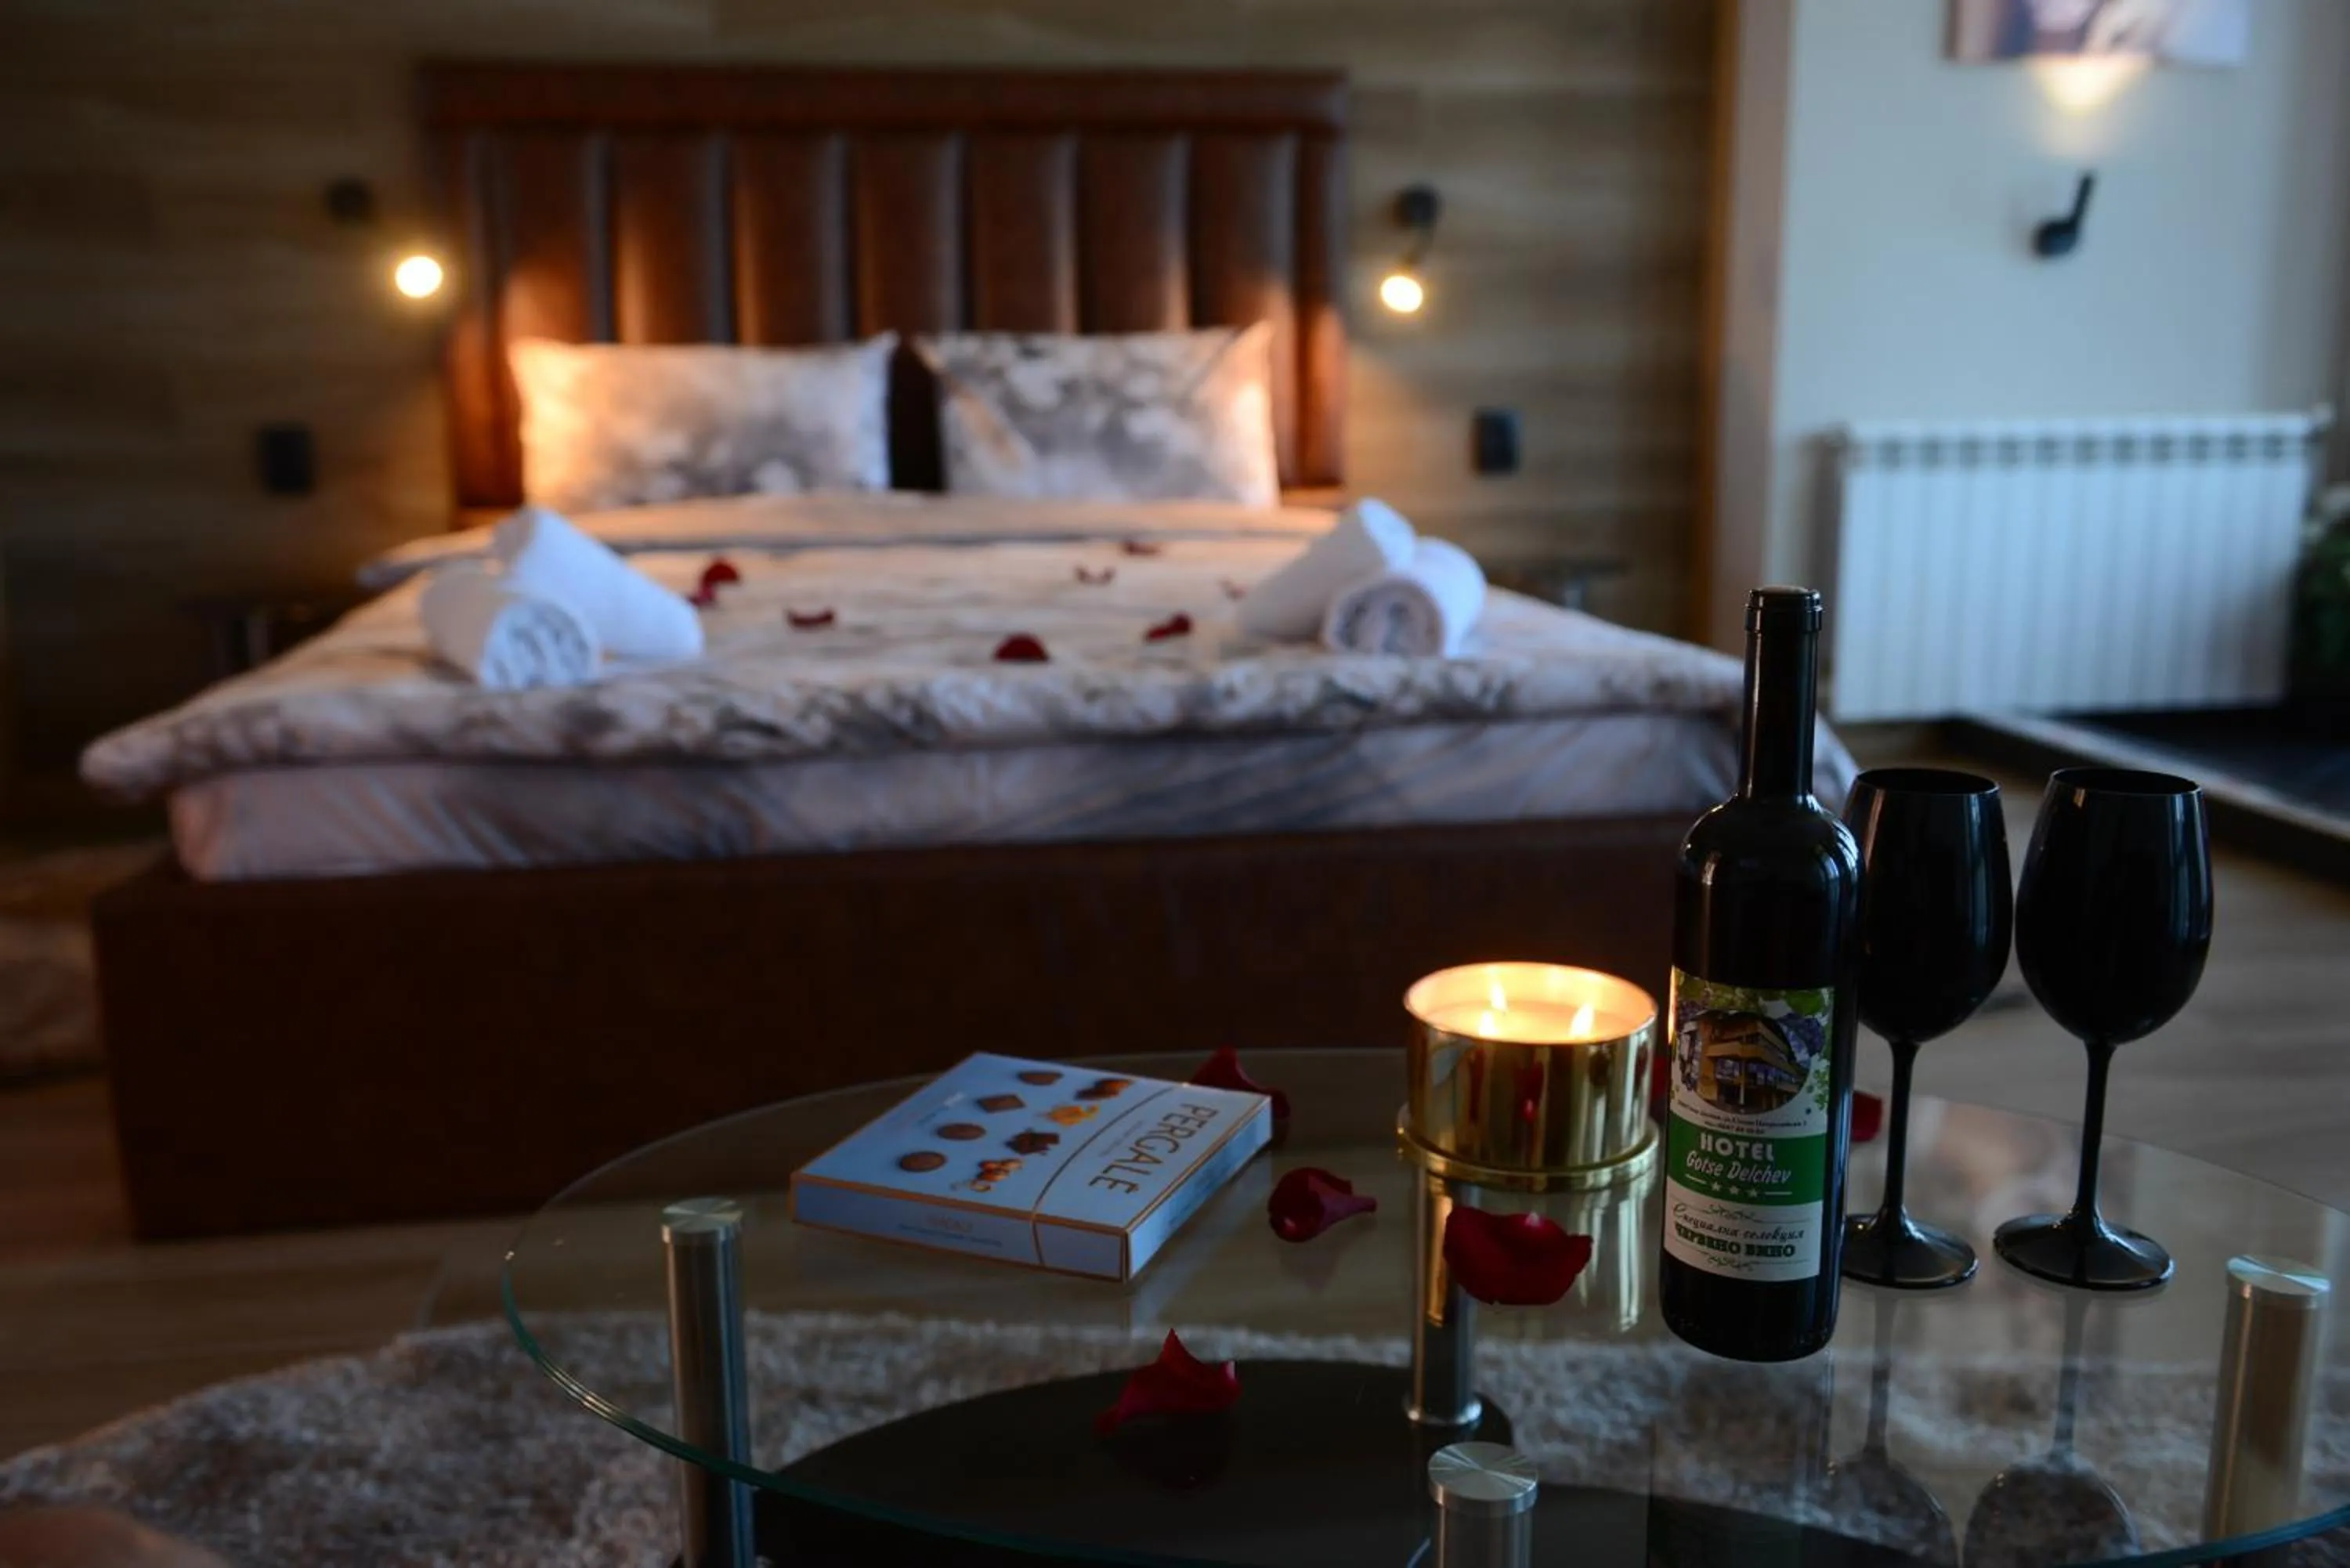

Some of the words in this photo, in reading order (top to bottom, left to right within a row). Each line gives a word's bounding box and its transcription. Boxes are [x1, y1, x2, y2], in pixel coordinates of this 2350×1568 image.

[1700, 1133, 1774, 1162] HOTEL
[1686, 1149, 1723, 1176] Gotse
[1728, 1161, 1791, 1185] Delchev
[1745, 1244, 1795, 1258] ВИНО
